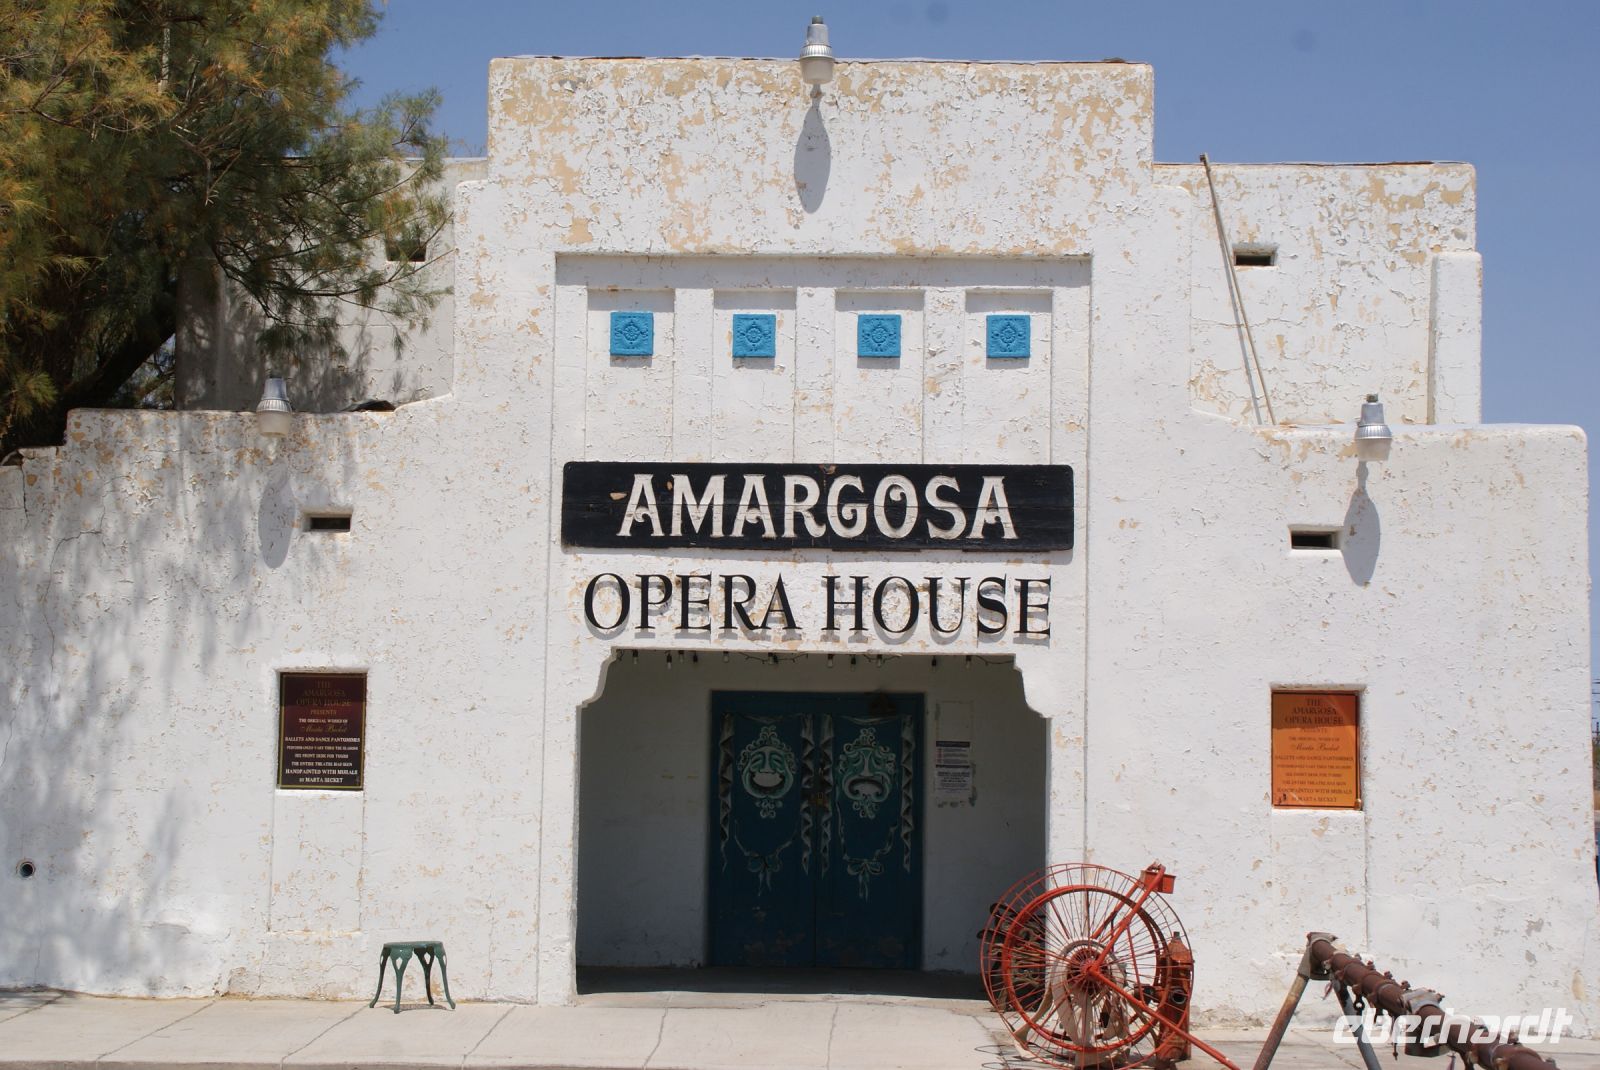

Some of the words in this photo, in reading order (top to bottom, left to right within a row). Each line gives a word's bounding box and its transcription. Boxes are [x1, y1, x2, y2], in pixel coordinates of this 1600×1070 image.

[615, 472, 1020, 541] AMARGOSA
[583, 570, 803, 631] OPERA
[820, 571, 1052, 637] HOUSE
[1284, 716, 1313, 724] OPERA
[1314, 716, 1344, 725] HOUSE
[1292, 706, 1337, 715] AMARGOSA
